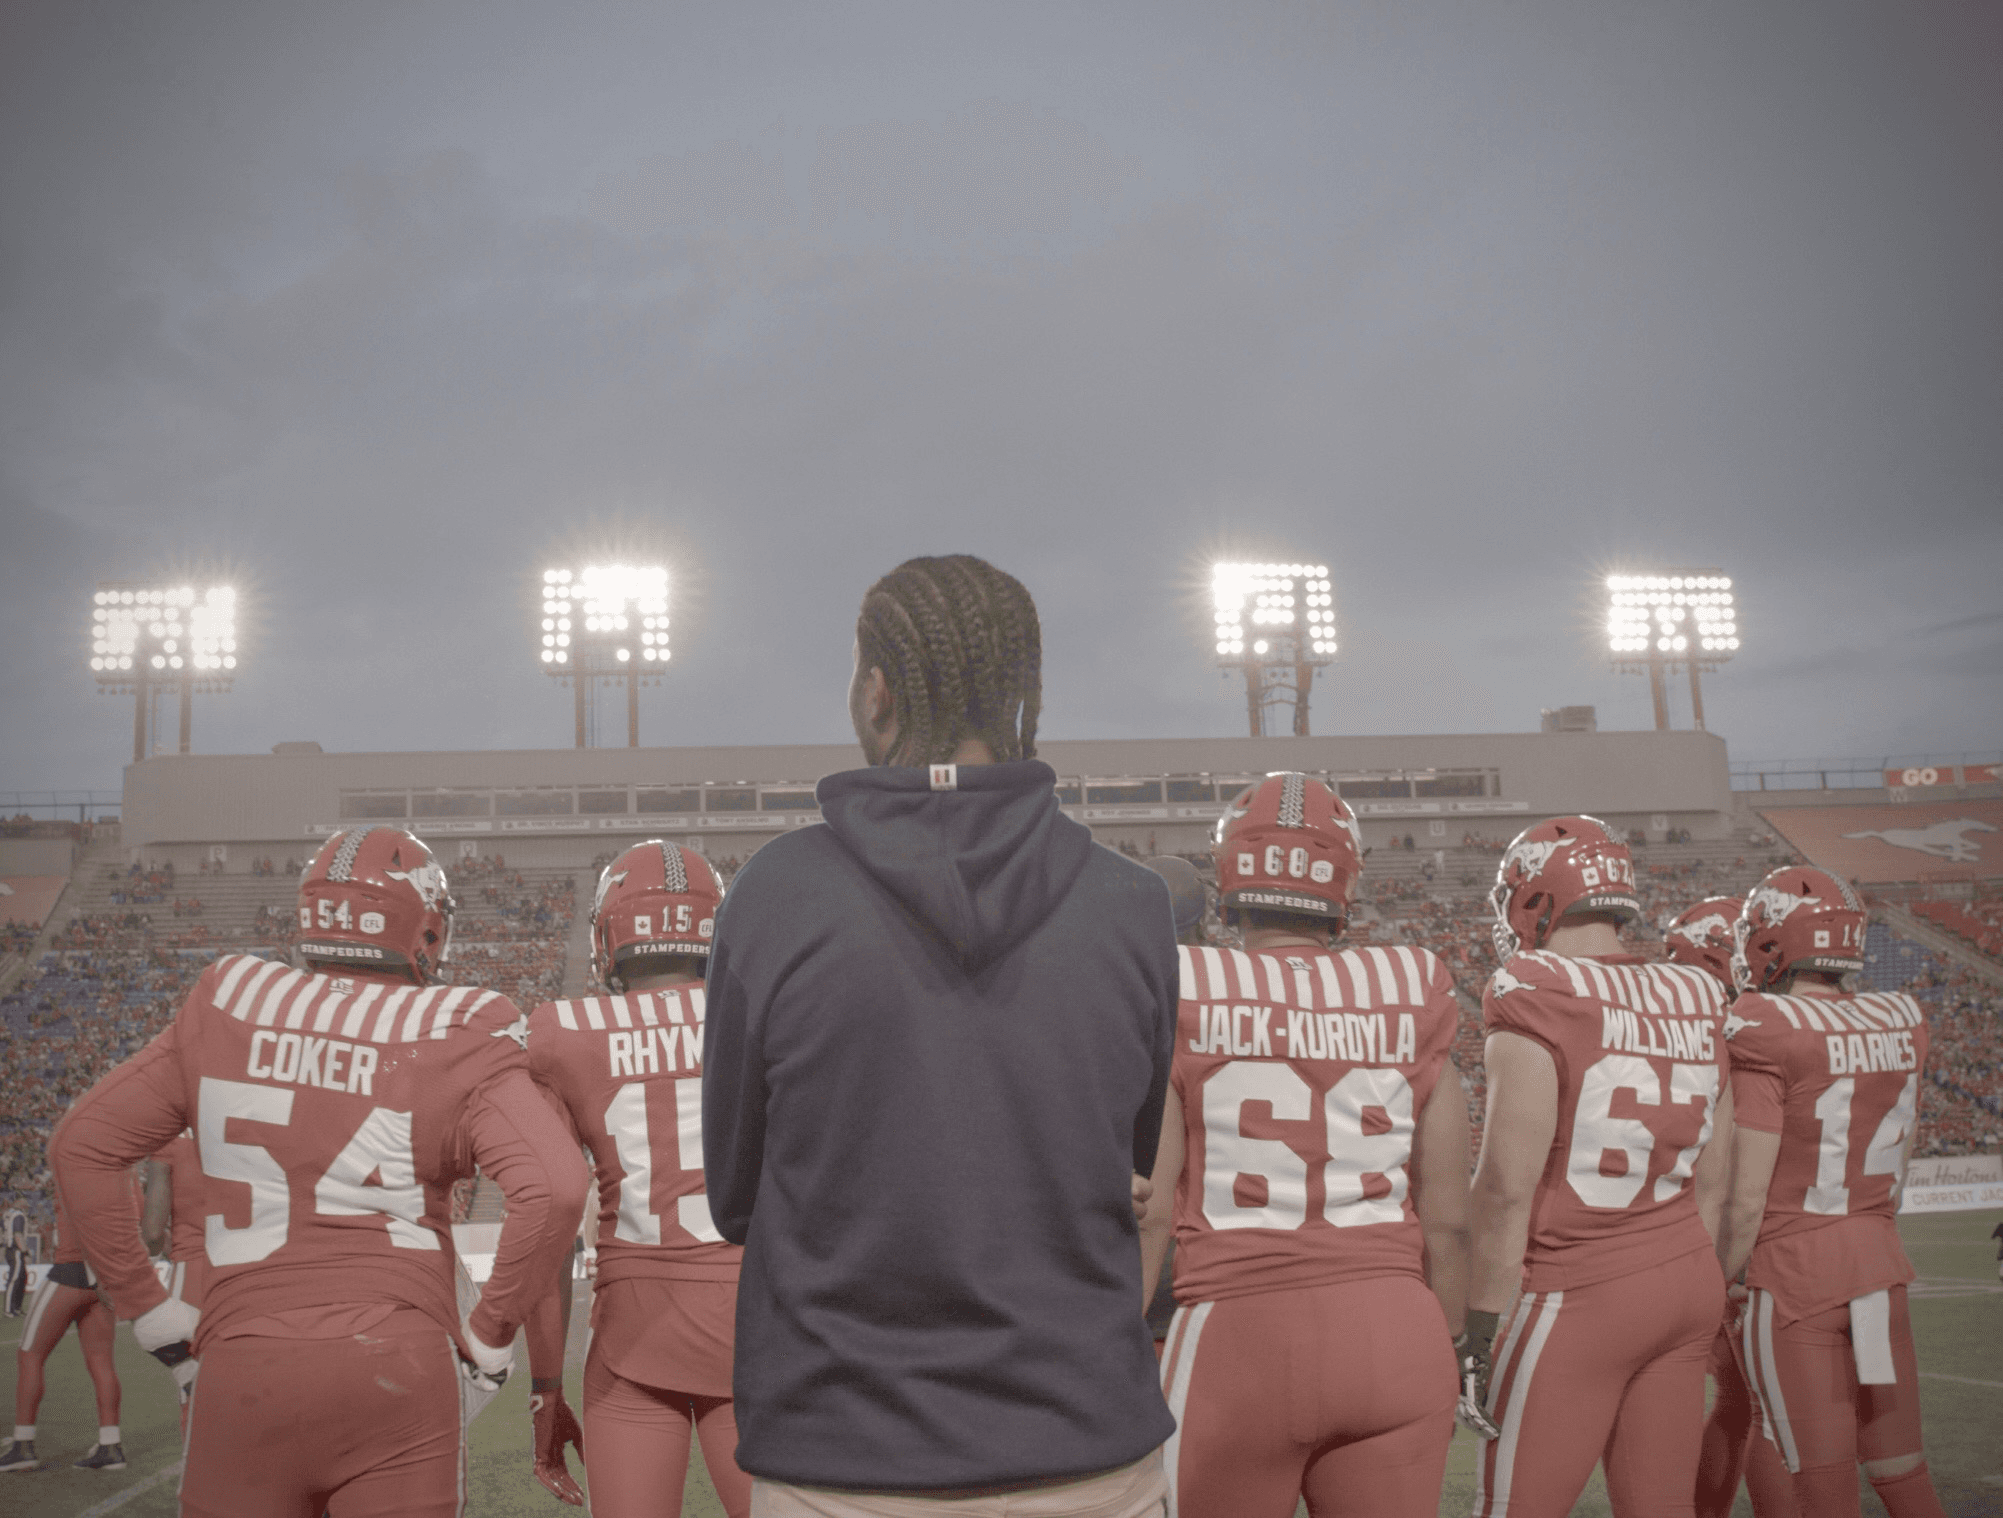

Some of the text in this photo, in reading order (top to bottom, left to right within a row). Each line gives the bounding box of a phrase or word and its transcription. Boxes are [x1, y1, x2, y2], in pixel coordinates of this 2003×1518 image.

[1902, 768, 1938, 787] GO
[1264, 845, 1309, 878] 68
[317, 898, 353, 930] 54
[662, 904, 693, 933] 15
[1239, 892, 1328, 912] STAMPEDERS
[300, 943, 383, 959] STAMPEDERS
[634, 943, 711, 955] STAMPEDERS
[1188, 1004, 1416, 1064] JACK-KURDYLA
[1601, 1005, 1716, 1061] WILLIAMS
[246, 1029, 379, 1096] COKER
[1825, 1031, 1917, 1076] BARNES
[1202, 1061, 1416, 1231] 68
[1566, 1053, 1720, 1210] 67
[1803, 1072, 1918, 1216] 14
[199, 1075, 442, 1267] 54
[1933, 1164, 1998, 1186] Hortons
[1911, 1189, 1974, 1206] CURRENT
